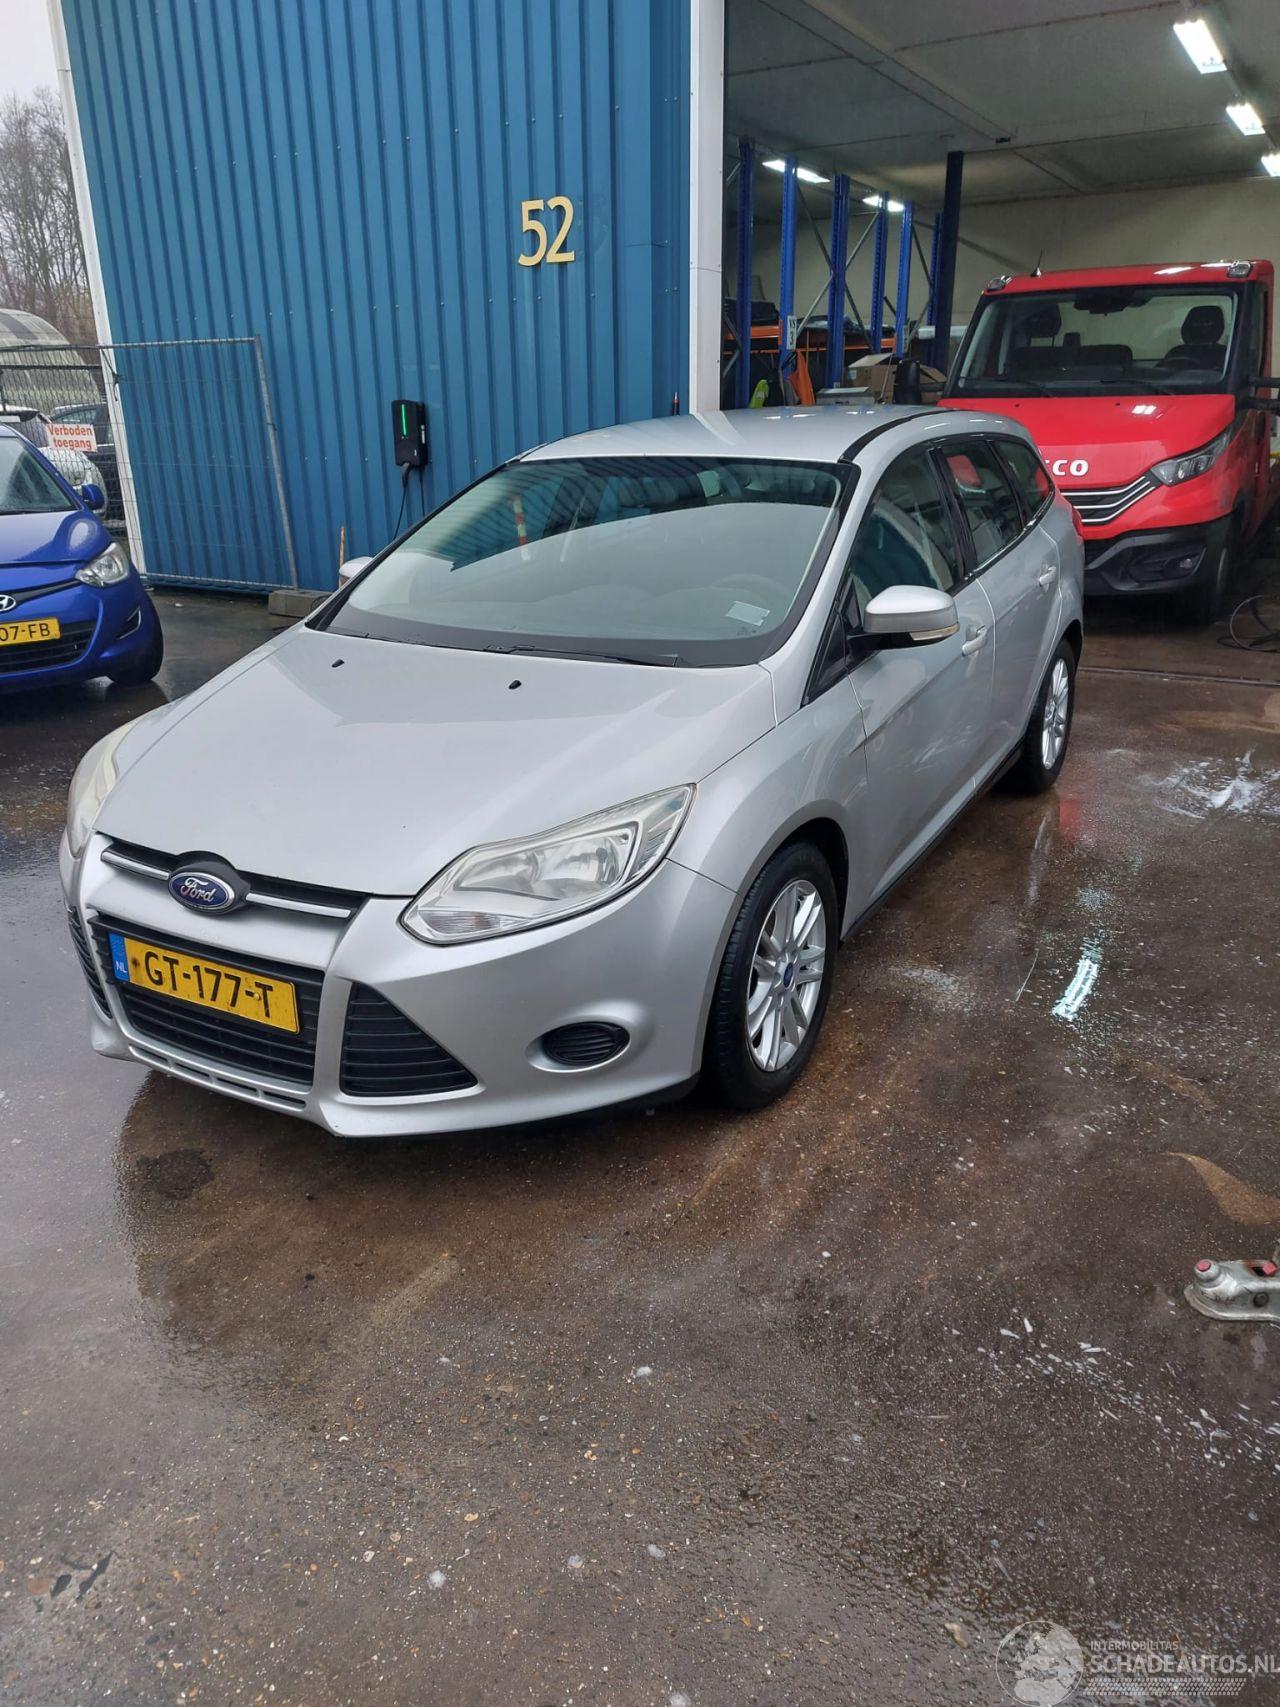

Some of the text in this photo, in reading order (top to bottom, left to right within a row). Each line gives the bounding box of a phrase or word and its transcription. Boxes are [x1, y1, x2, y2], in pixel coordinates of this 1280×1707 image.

[518, 196, 574, 266] 52
[47, 424, 93, 436] Verboden
[53, 438, 92, 451] toegang
[1045, 459, 1089, 476] CO
[180, 877, 215, 903] Ford
[115, 961, 128, 973] NL
[144, 951, 273, 1018] GT-177-T
